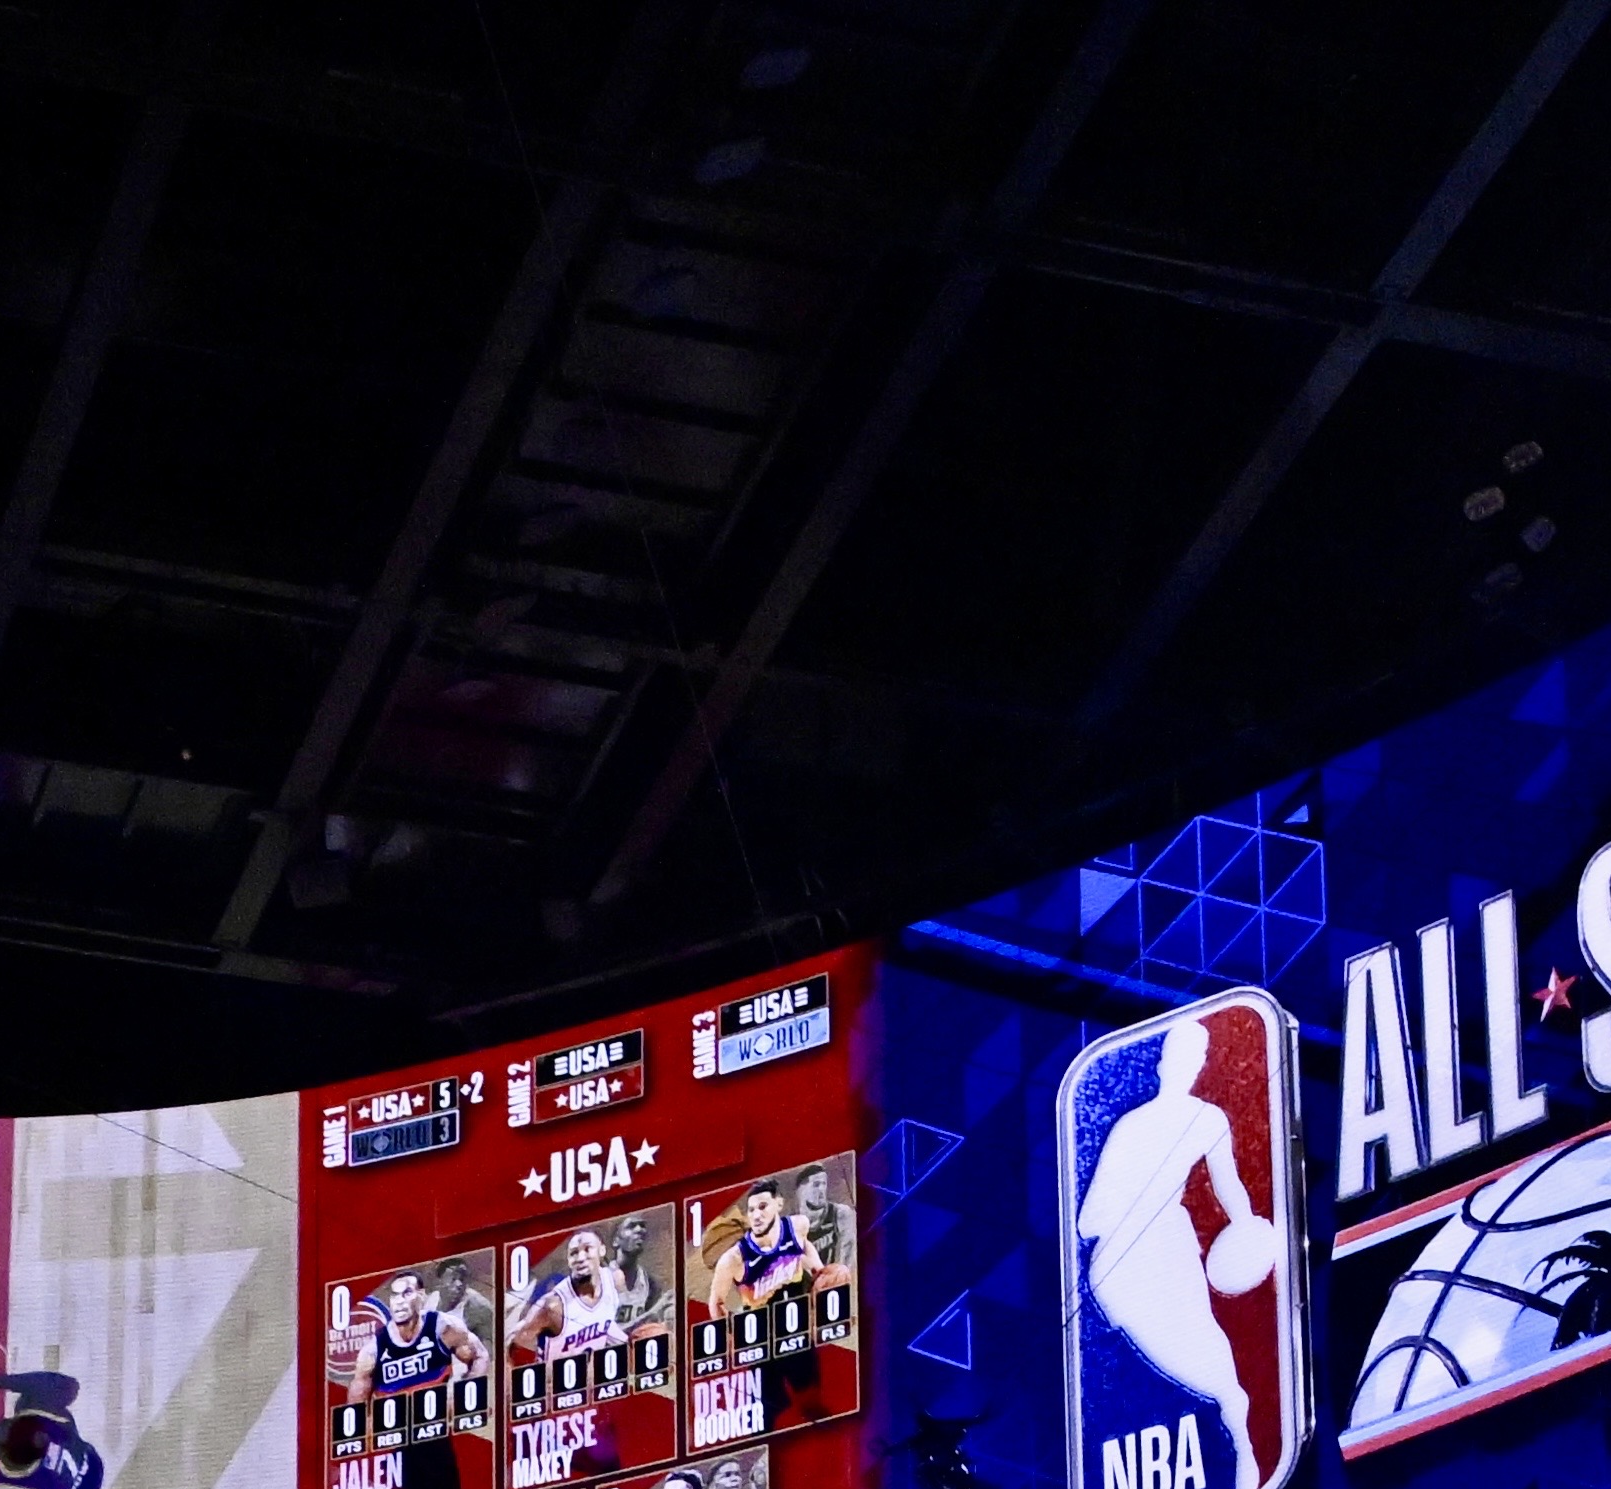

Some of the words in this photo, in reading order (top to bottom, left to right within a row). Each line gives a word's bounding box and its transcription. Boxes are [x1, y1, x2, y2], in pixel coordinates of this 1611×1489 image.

[693, 1010, 716, 1026] 3
[753, 996, 793, 1024] USA
[569, 1045, 609, 1072] USA
[693, 1030, 716, 1079] GAME
[739, 1017, 811, 1062] WORLD
[1338, 890, 1551, 1202] ALL
[508, 1060, 530, 1075] 2
[372, 1092, 413, 1123] USA
[439, 1081, 451, 1108] 5
[460, 1071, 484, 1104] +2
[508, 1077, 530, 1128] GAME
[569, 1077, 610, 1111] USA
[323, 1118, 346, 1168] GAME
[440, 1117, 450, 1142] 3
[550, 1136, 632, 1203] USA
[689, 1201, 703, 1247] 1
[511, 1246, 529, 1291] 0
[332, 1286, 350, 1331] 0
[704, 1324, 716, 1354] 0
[745, 1314, 757, 1344] 0
[786, 1302, 798, 1332] 0
[827, 1290, 839, 1321] 0
[382, 1352, 431, 1383] DET
[698, 1358, 723, 1374] PTS
[739, 1348, 763, 1364] REB
[780, 1336, 805, 1353] AST
[822, 1325, 845, 1341] FLS
[694, 1368, 762, 1419] DEVIN
[512, 1409, 598, 1456] TYRESE
[694, 1401, 764, 1448] BOOKER
[512, 1450, 574, 1489] MAXEY
